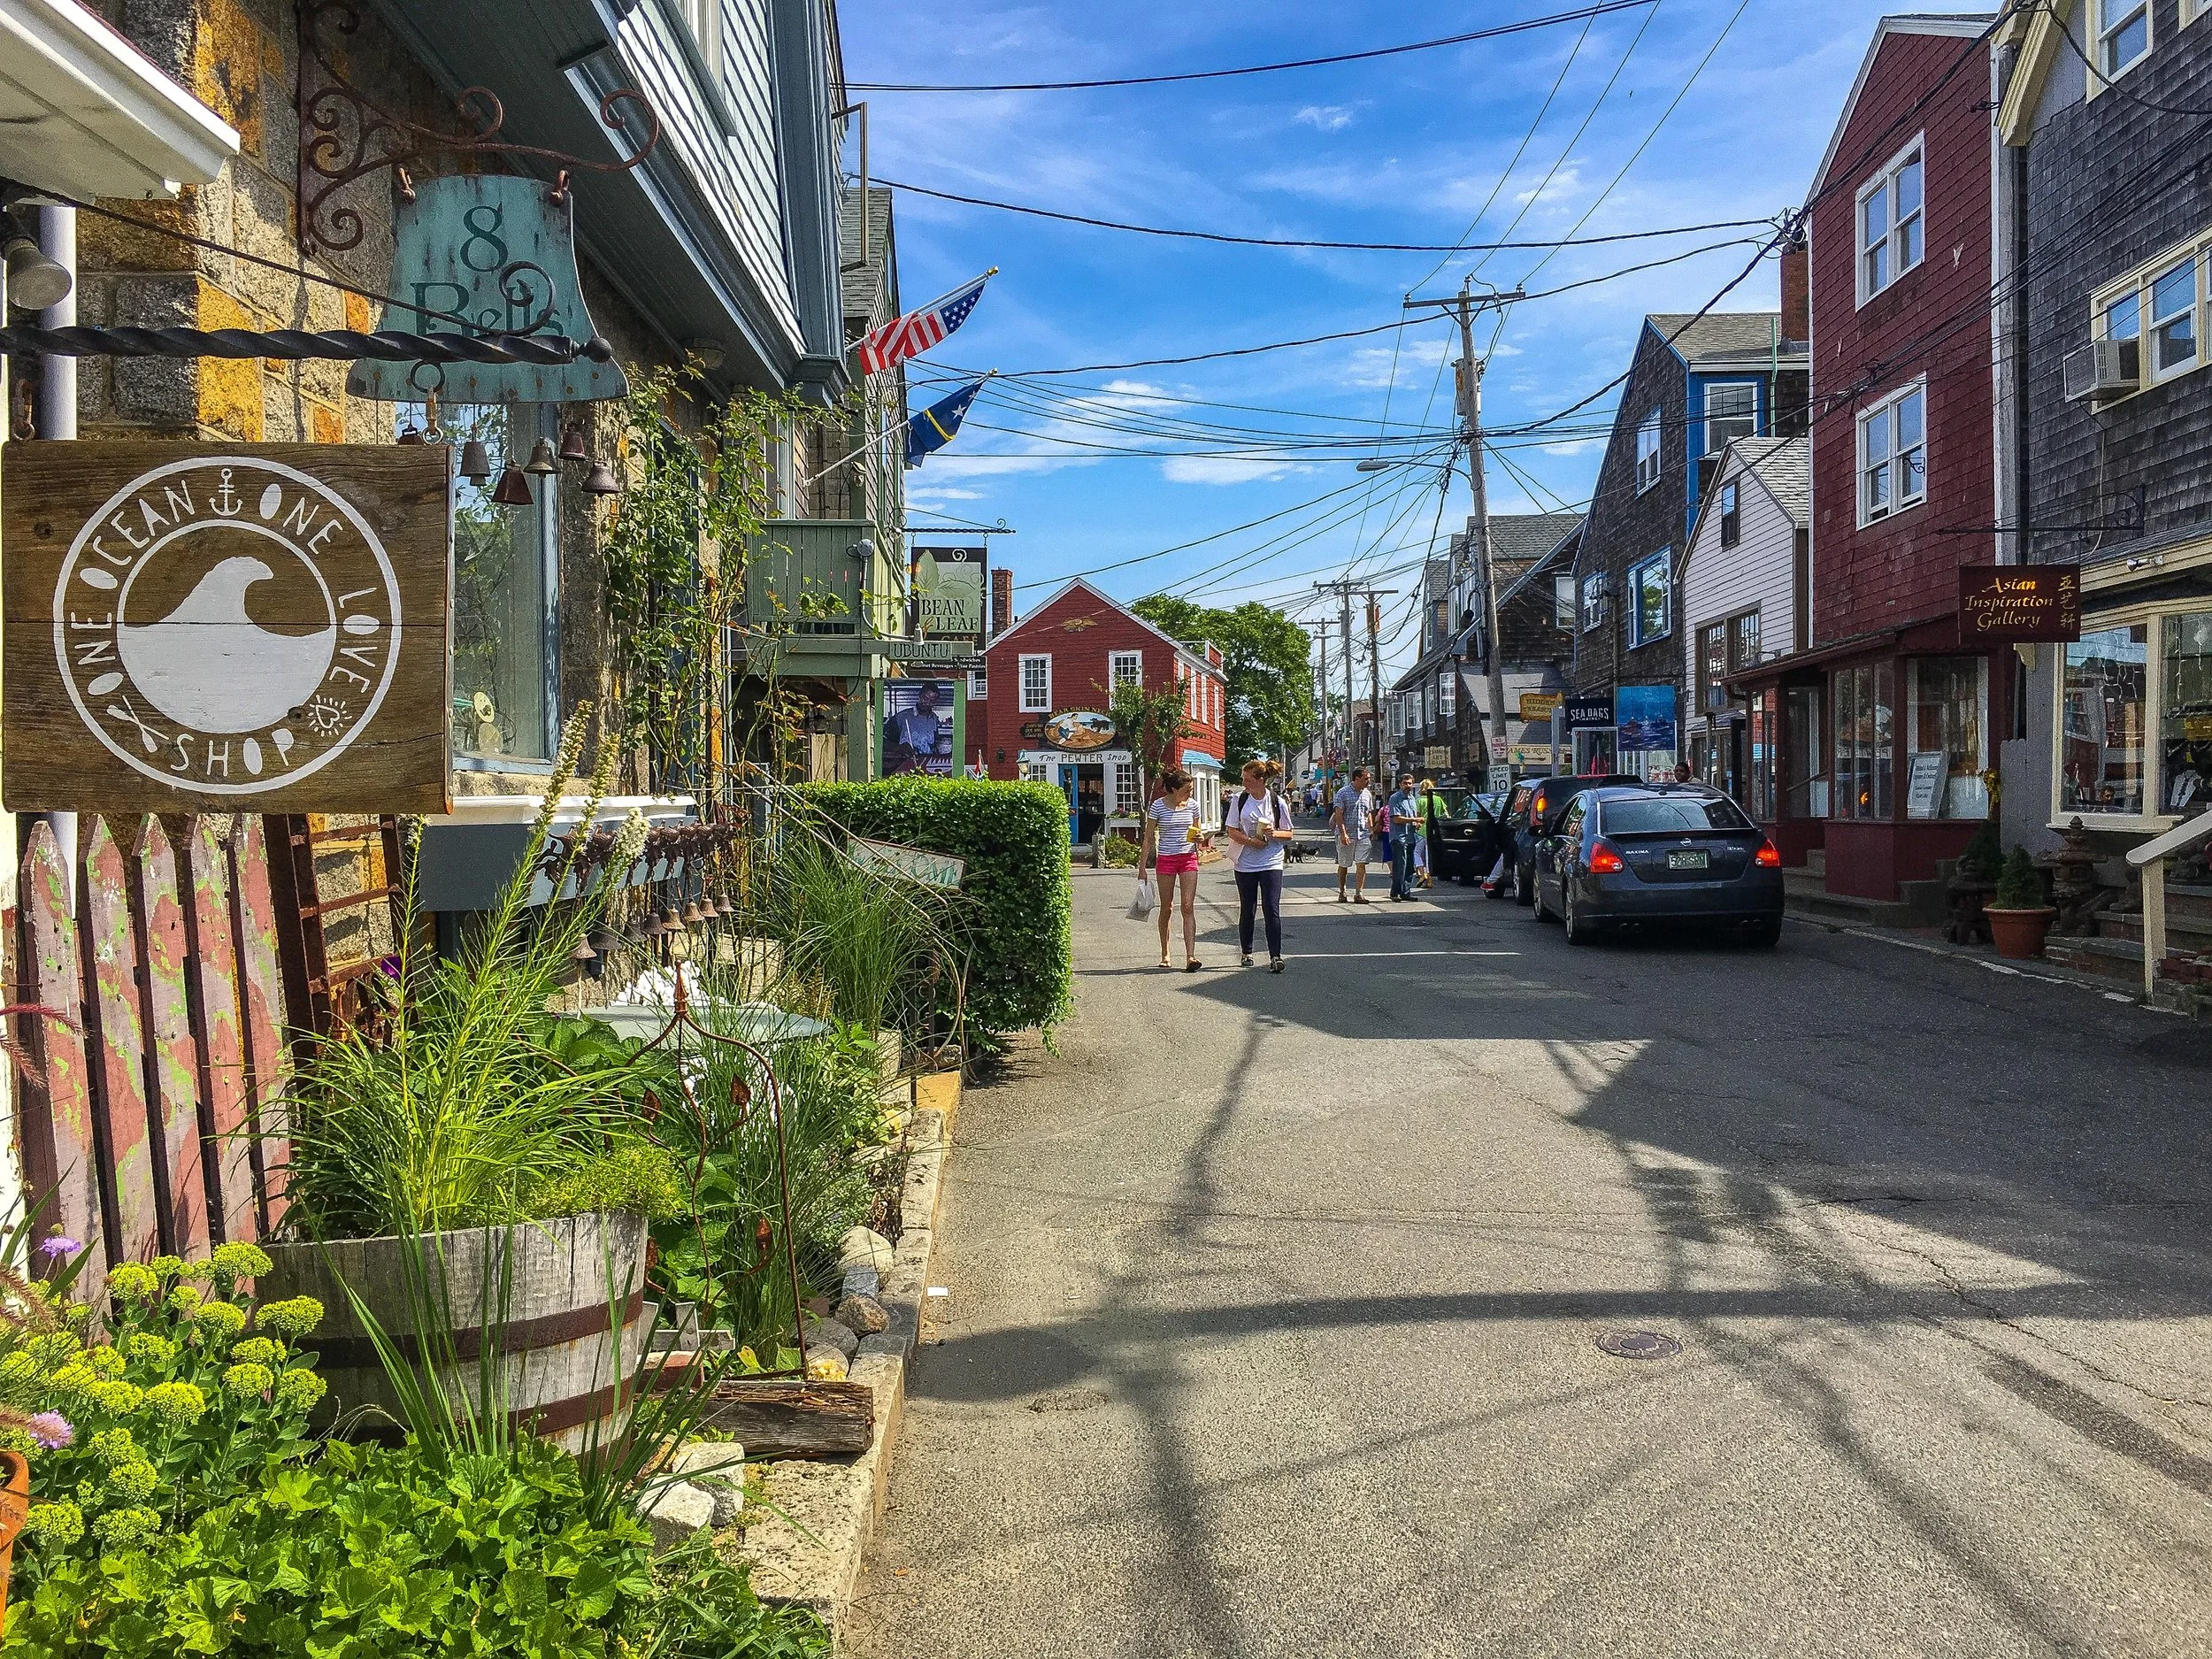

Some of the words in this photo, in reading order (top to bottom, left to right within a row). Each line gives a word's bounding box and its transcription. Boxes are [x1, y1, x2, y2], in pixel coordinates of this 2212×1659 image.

[459, 204, 509, 273] 8
[259, 483, 343, 555] ONE
[79, 480, 196, 589] OCEAN
[1981, 577, 2037, 594] Asian
[922, 600, 964, 616] BEAN
[1964, 594, 2053, 611] Inspiration
[935, 617, 979, 630] LEAF
[1977, 611, 2041, 632] Gallery
[328, 587, 380, 695] LOVE
[70, 611, 125, 696] ONE
[894, 643, 949, 657] UBUNTU
[1571, 708, 1586, 722] SEA
[1587, 707, 1609, 720] BAGS
[171, 727, 296, 776] SHOP
[1061, 753, 1103, 763] PEWTER
[1107, 753, 1127, 762] Shop
[1494, 780, 1508, 791] 10
